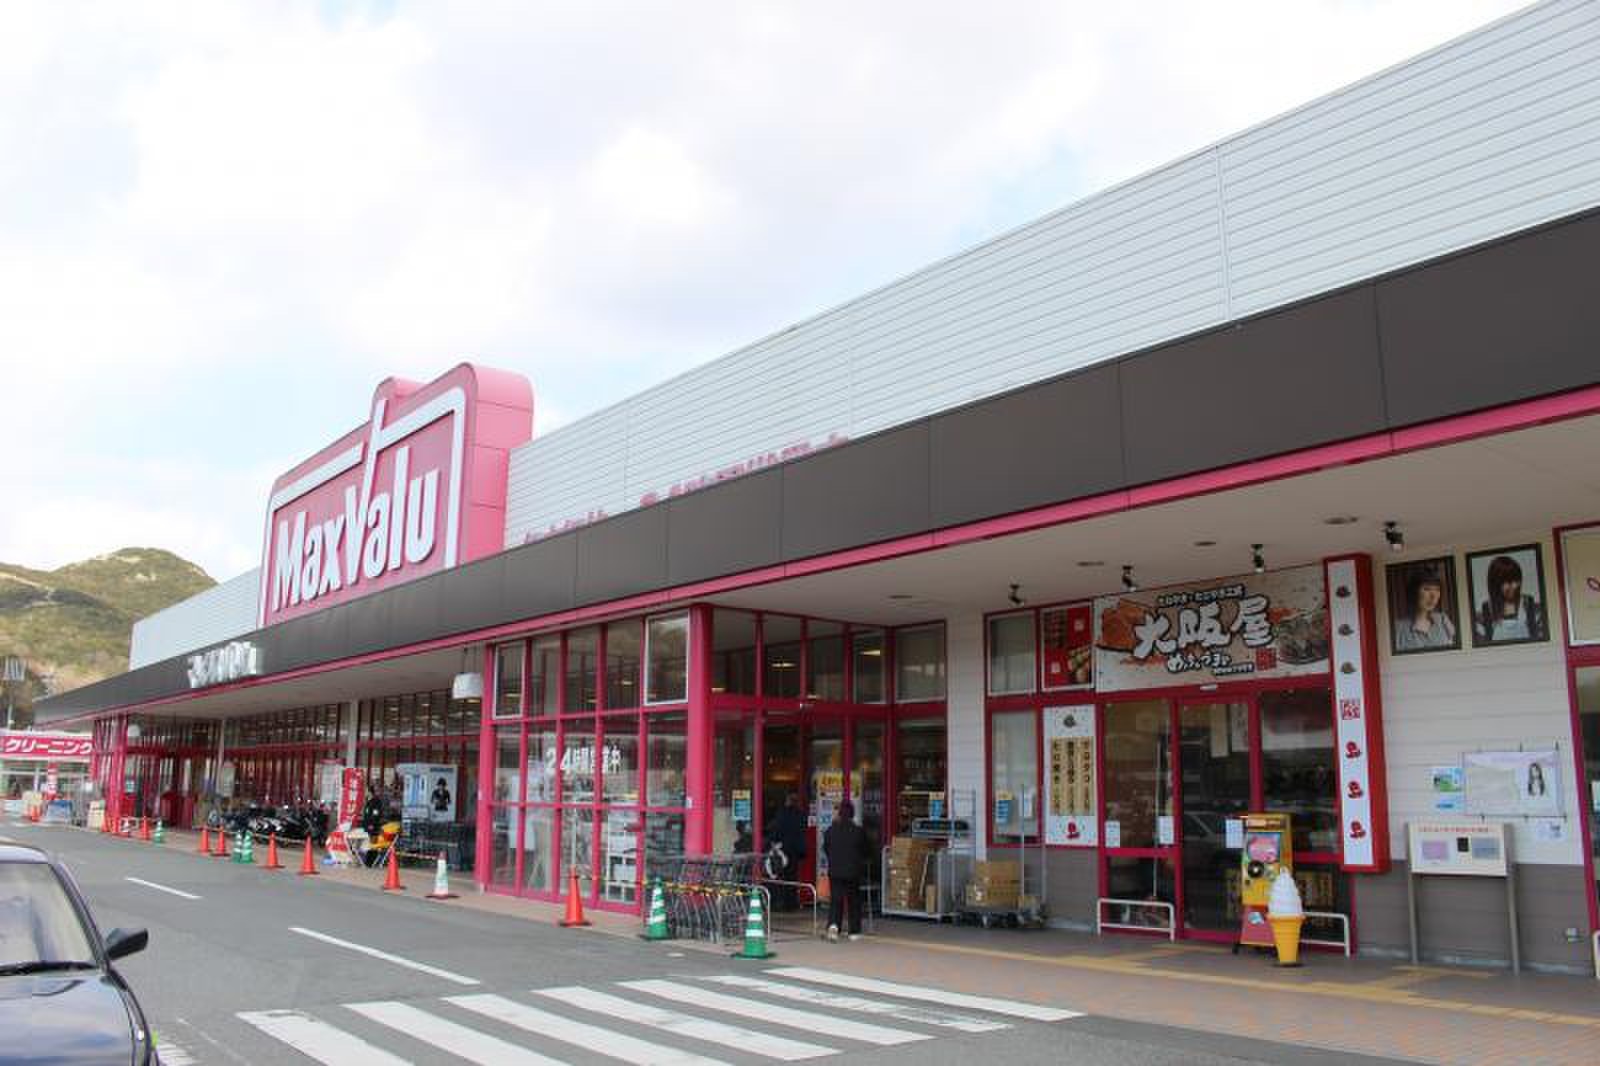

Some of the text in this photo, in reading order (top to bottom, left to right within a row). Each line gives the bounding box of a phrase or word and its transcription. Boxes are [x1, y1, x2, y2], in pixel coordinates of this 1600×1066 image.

[272, 438, 440, 613] MaxValu
[1132, 594, 1272, 660] 大阪屋
